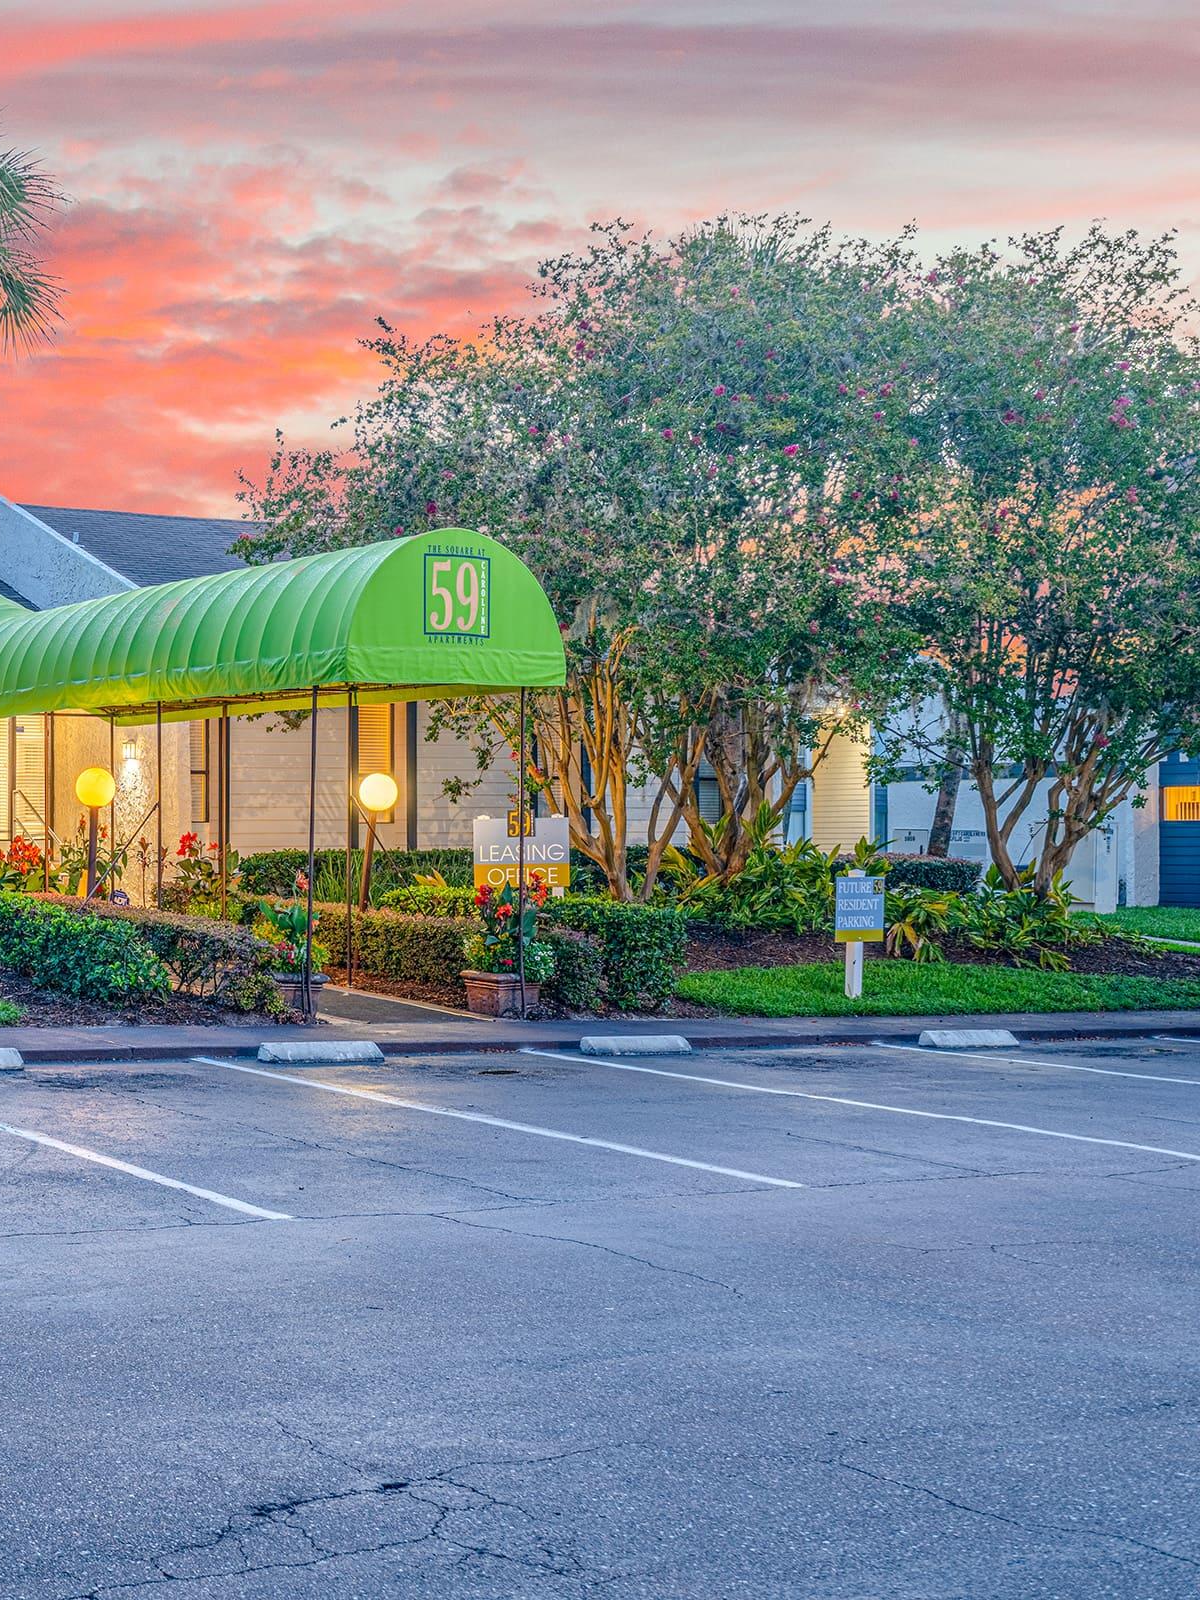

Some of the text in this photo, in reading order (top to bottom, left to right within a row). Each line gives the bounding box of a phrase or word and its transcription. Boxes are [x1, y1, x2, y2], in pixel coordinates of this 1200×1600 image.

[428, 545, 485, 557] THE SQUARE AT
[430, 559, 479, 631] 59
[428, 635, 484, 647] APARTMENTS
[479, 844, 565, 862] LEASING
[487, 867, 558, 885] OFFICE
[839, 881, 872, 893] FUTURE
[838, 898, 879, 911] RESIDENT
[838, 916, 874, 928] PARKING
